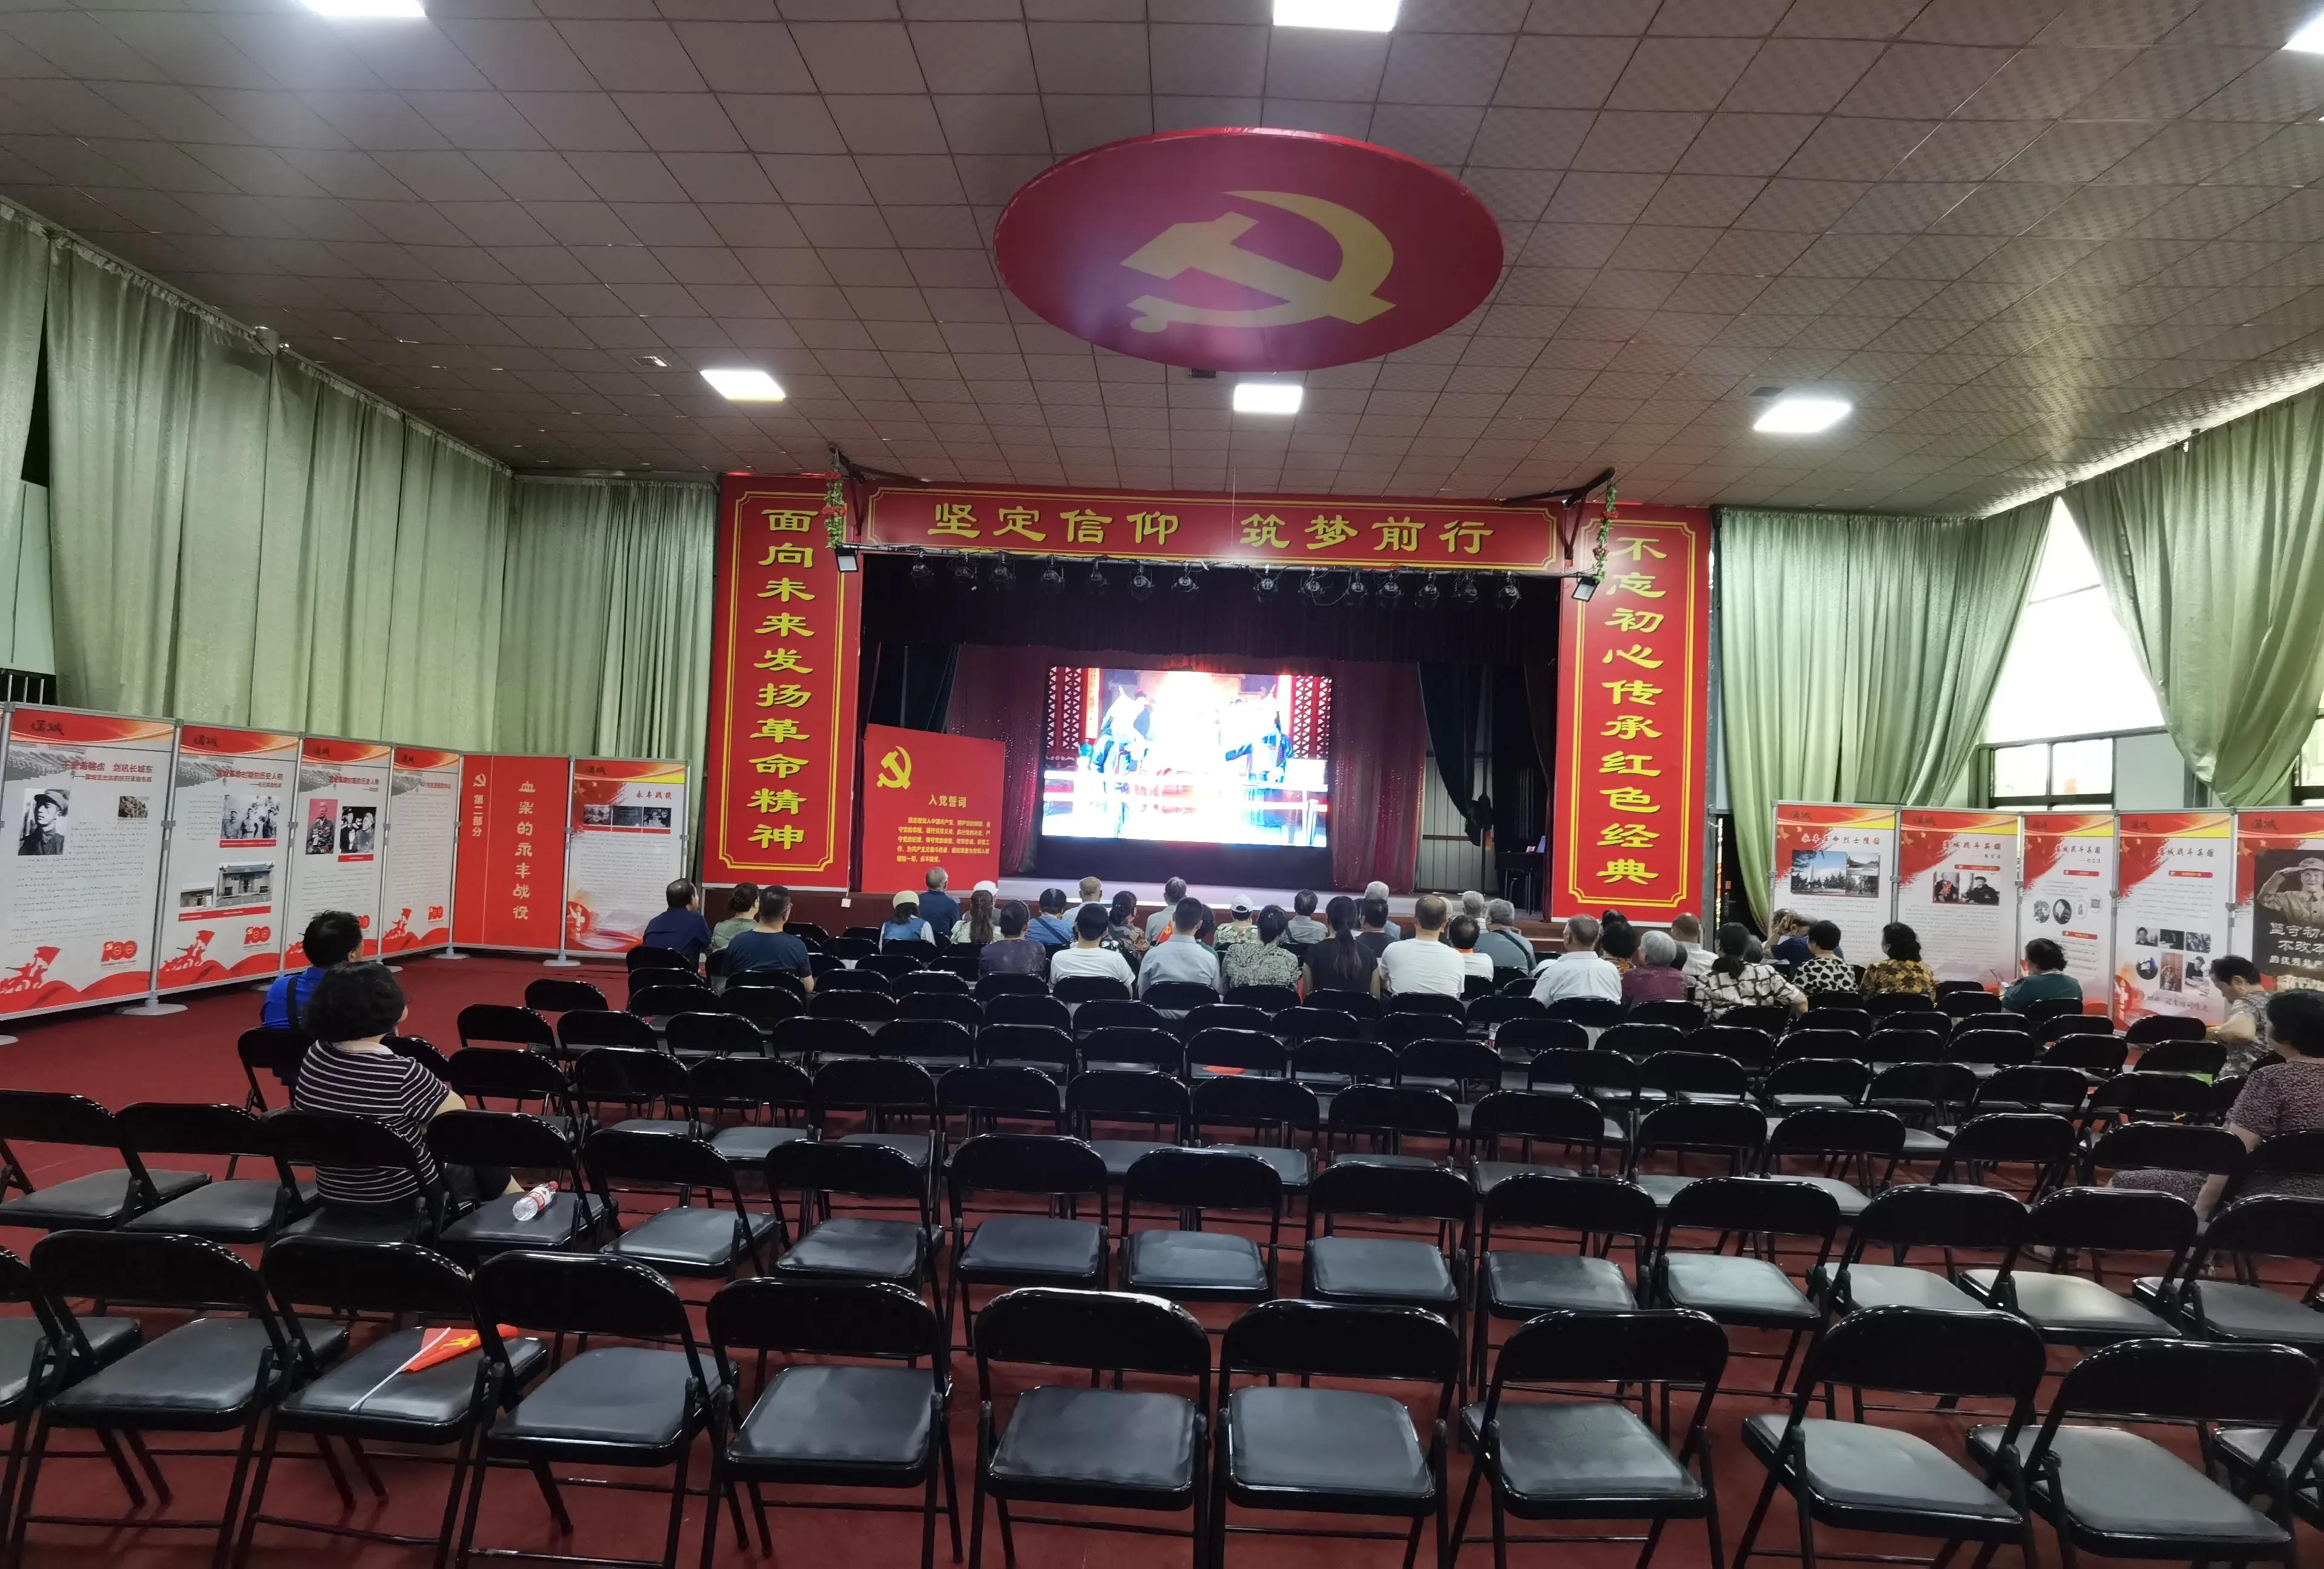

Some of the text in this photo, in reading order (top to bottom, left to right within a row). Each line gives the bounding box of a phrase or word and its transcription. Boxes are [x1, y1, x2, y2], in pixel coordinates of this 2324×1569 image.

[928, 503, 1492, 554] 坚定信仰 筑梦前行
[747, 509, 817, 850] 面向未来发扬革命精神
[1596, 536, 1667, 886] 不忘初心传承红色经典
[473, 794, 484, 837] 第二部分
[928, 794, 967, 808] 入党誓词
[513, 780, 536, 919] 血染的永丰战役
[2269, 921, 2324, 939] 坚守初
